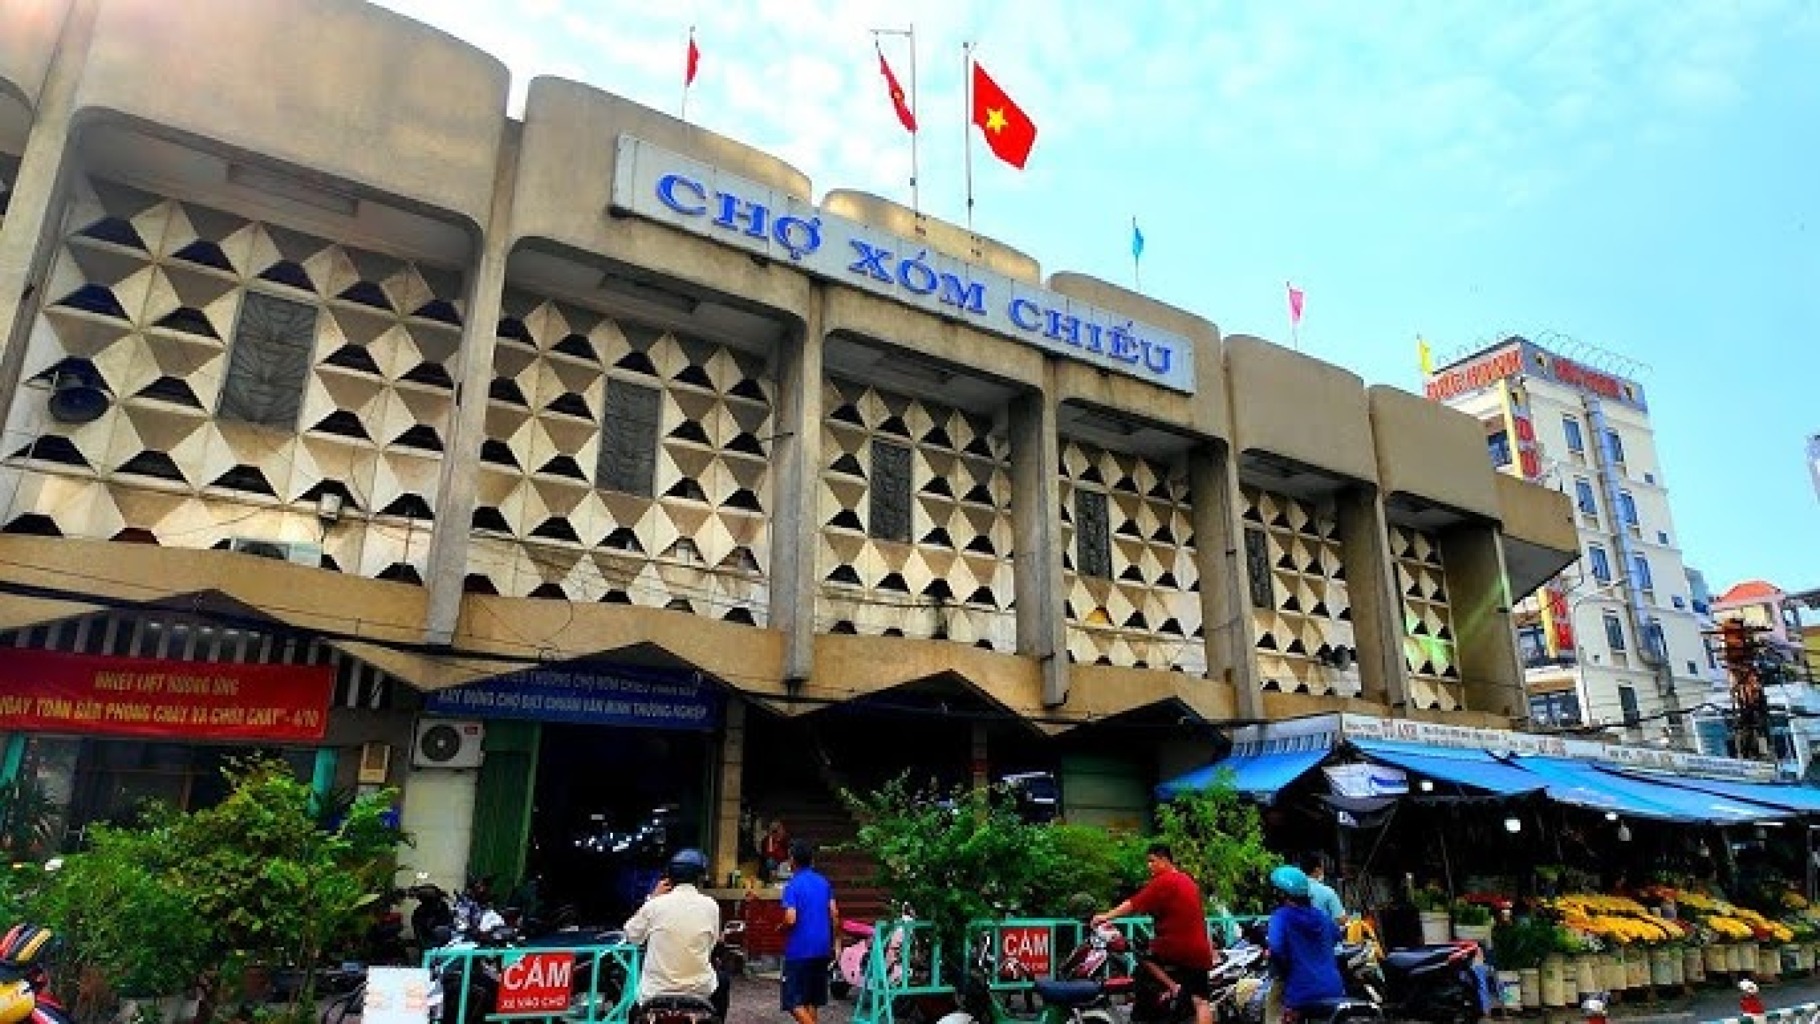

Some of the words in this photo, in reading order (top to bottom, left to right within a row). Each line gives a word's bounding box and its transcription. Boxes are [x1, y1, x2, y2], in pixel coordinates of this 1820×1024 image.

[655, 174, 822, 261] CHỢ
[848, 238, 988, 316] XÓM
[1009, 297, 1172, 375] CHIẾU
